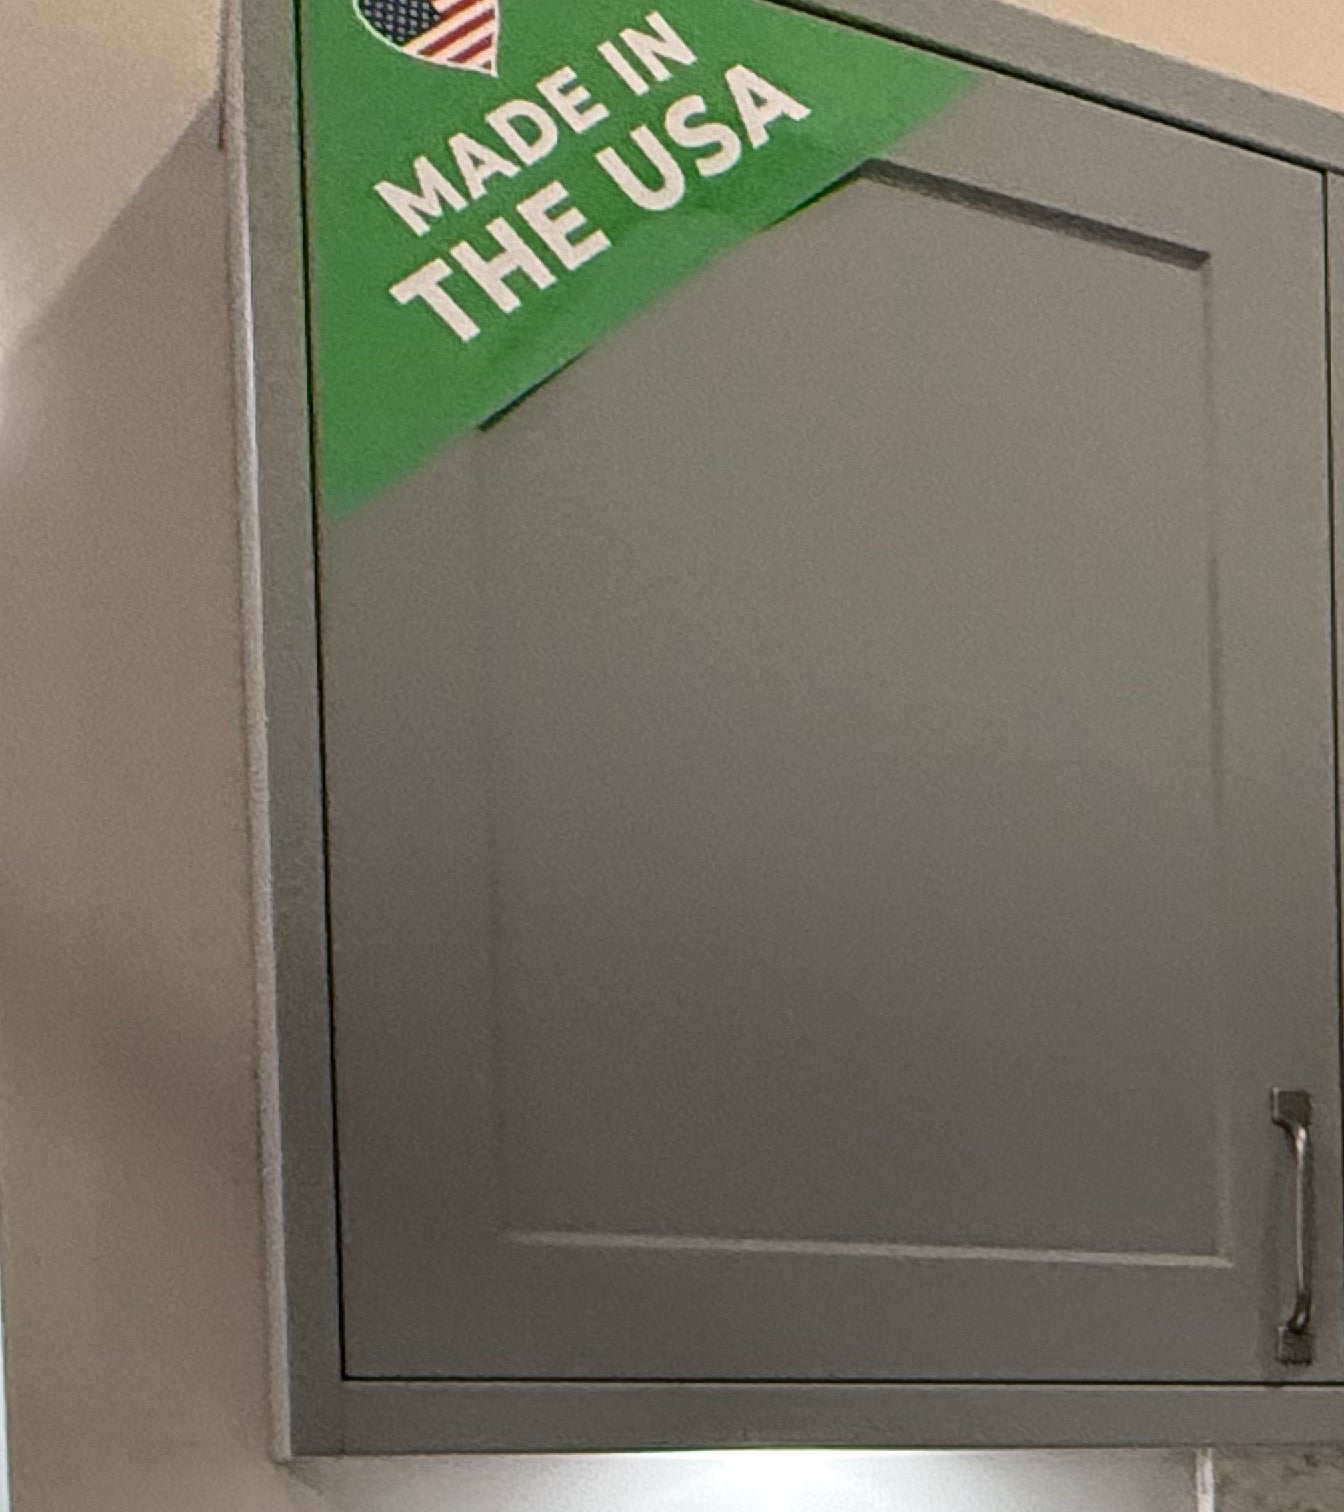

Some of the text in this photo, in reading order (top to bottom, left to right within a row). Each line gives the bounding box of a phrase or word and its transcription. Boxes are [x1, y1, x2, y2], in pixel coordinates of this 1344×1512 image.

[375, 11, 698, 235] MADE IN
[388, 64, 811, 342] THE USA
